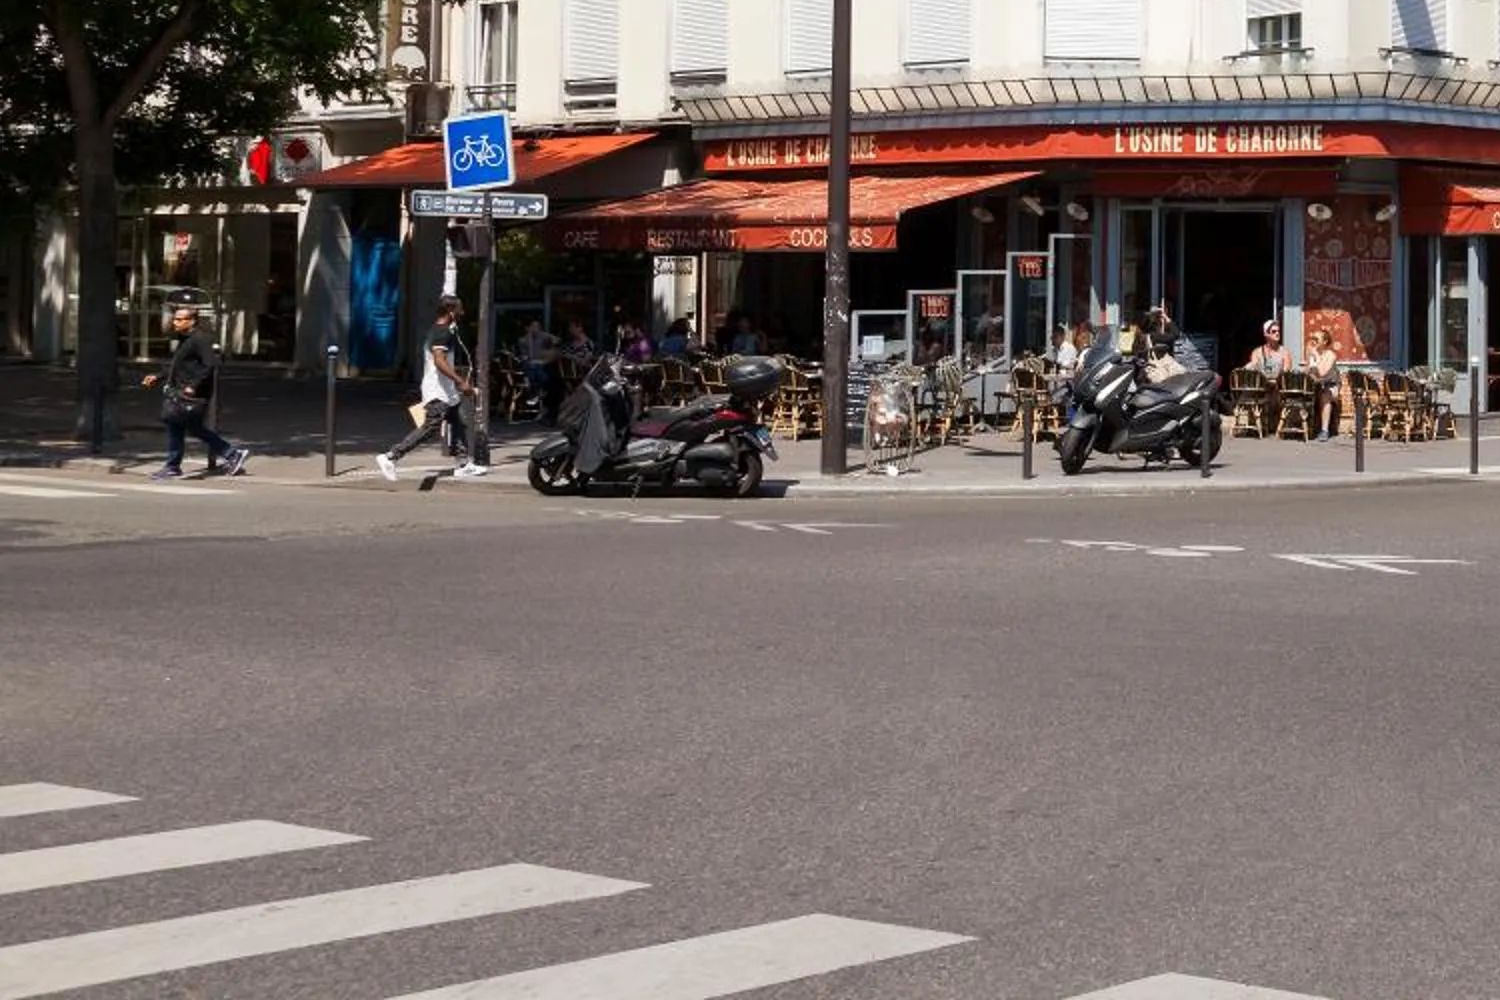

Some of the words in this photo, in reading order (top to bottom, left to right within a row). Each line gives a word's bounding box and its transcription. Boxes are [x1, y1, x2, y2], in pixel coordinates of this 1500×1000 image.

[784, 138, 801, 165] DE
[1114, 125, 1183, 153] L'USINE
[1195, 126, 1218, 153] DE
[1226, 124, 1324, 153] CHARONNE
[646, 229, 737, 250] RESTAURANT
